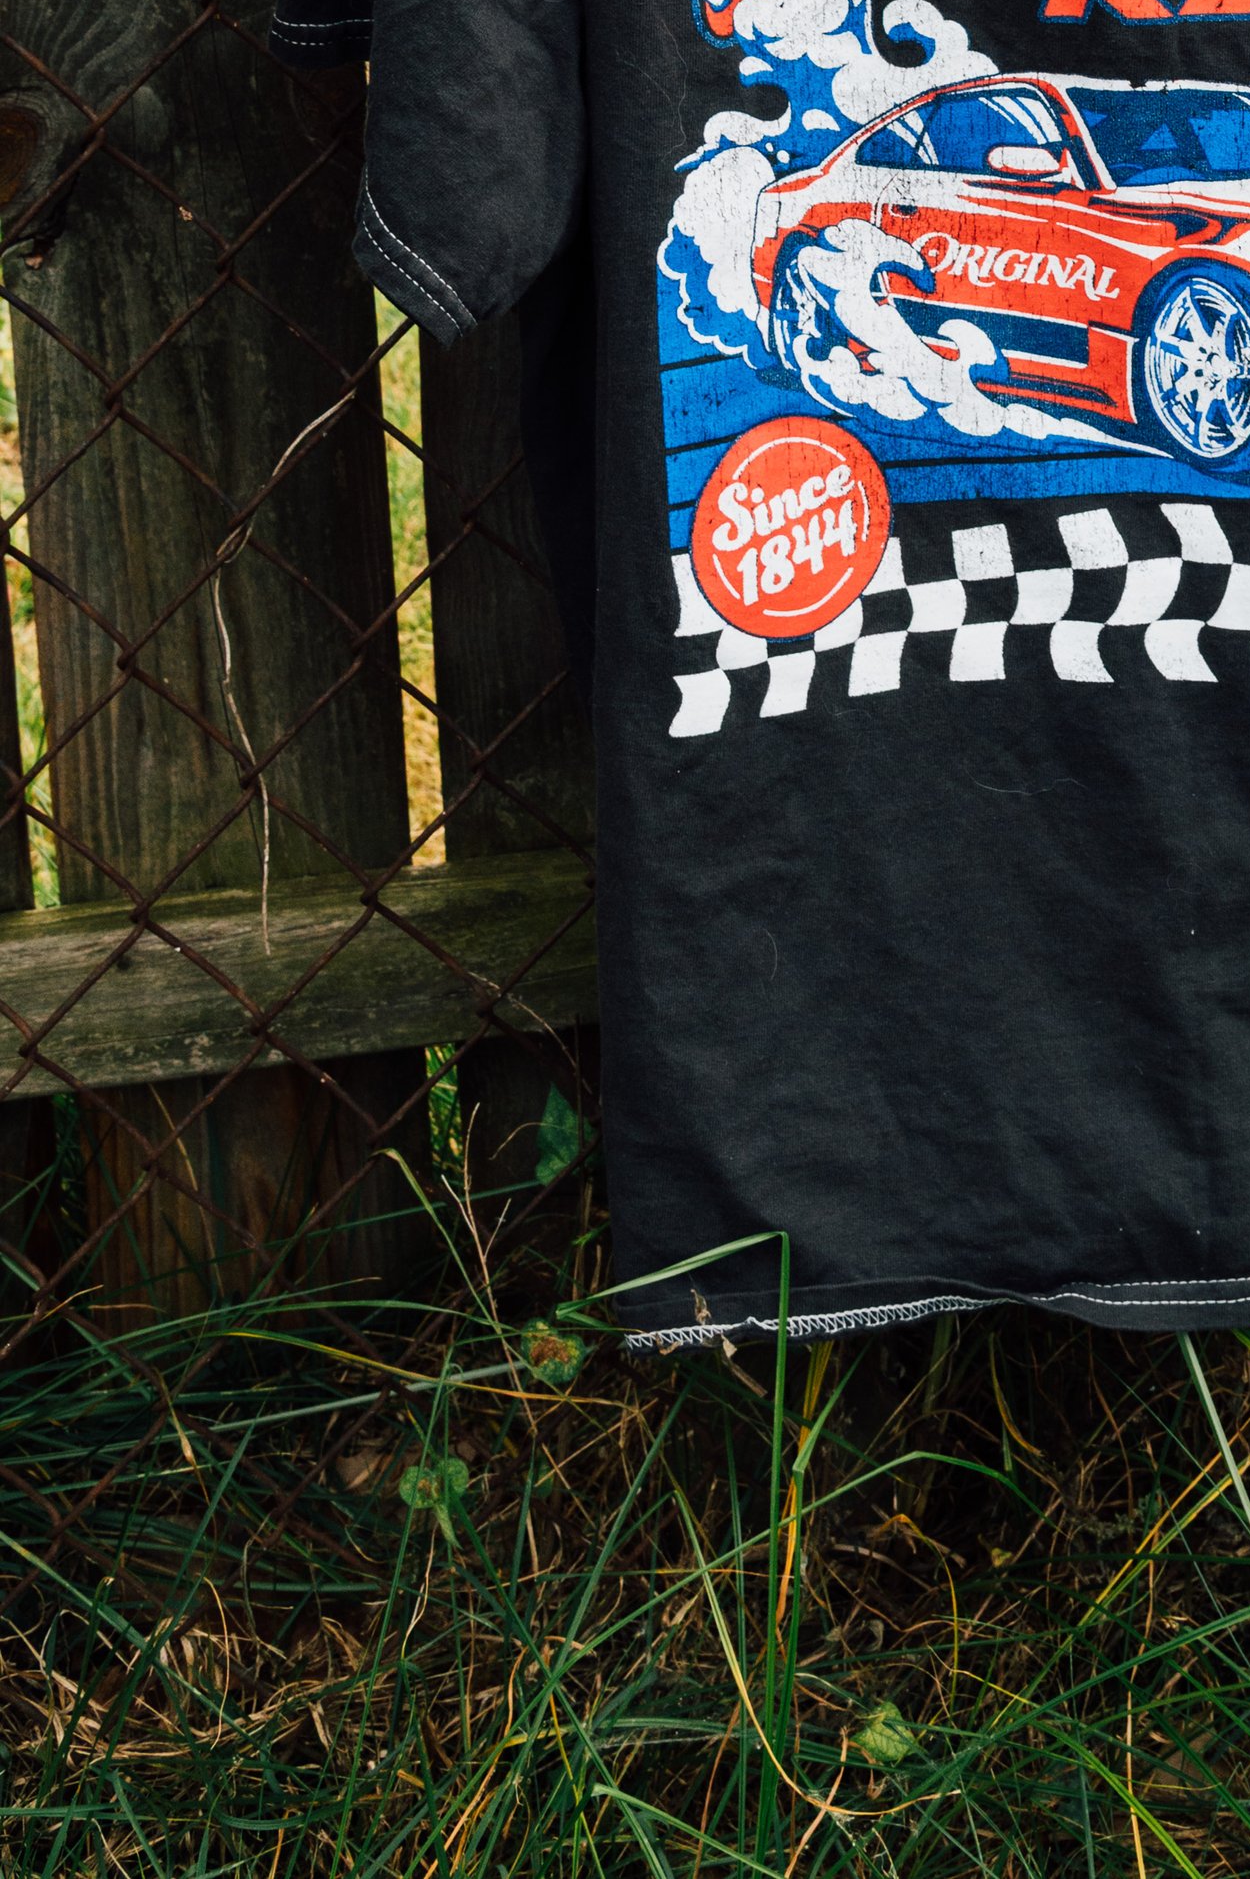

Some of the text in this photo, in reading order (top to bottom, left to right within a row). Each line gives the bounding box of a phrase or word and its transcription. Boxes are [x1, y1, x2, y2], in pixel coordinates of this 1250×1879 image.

[911, 231, 1121, 302] ORIGINAL
[712, 464, 856, 552] Since
[736, 500, 858, 606] 1844
